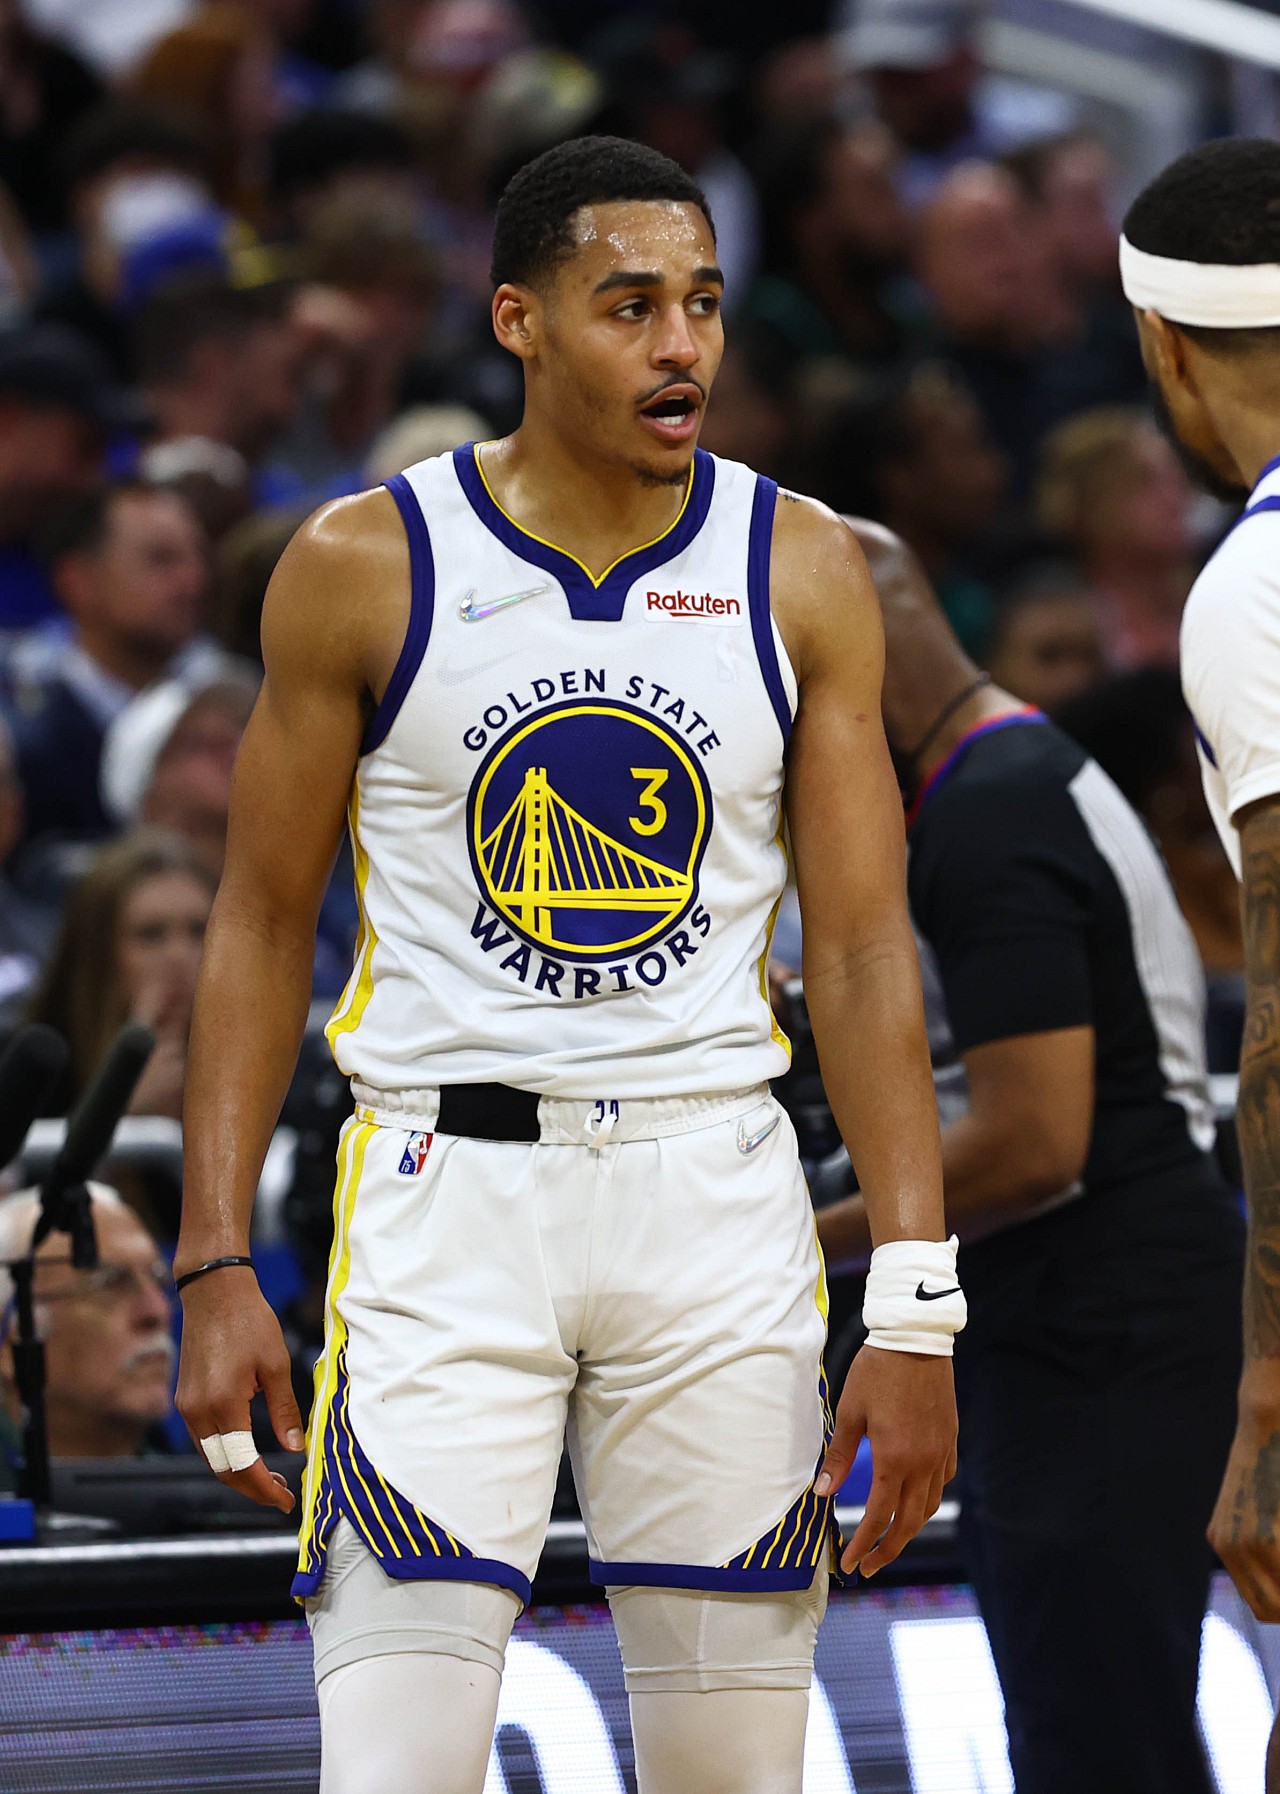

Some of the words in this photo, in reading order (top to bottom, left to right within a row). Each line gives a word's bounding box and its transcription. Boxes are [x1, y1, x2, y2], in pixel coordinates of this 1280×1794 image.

[646, 590, 741, 617] Rakuten
[463, 668, 606, 752] GOLDEN
[625, 675, 721, 757] STATE
[627, 767, 669, 837] 3
[469, 901, 712, 999] WARRIORS
